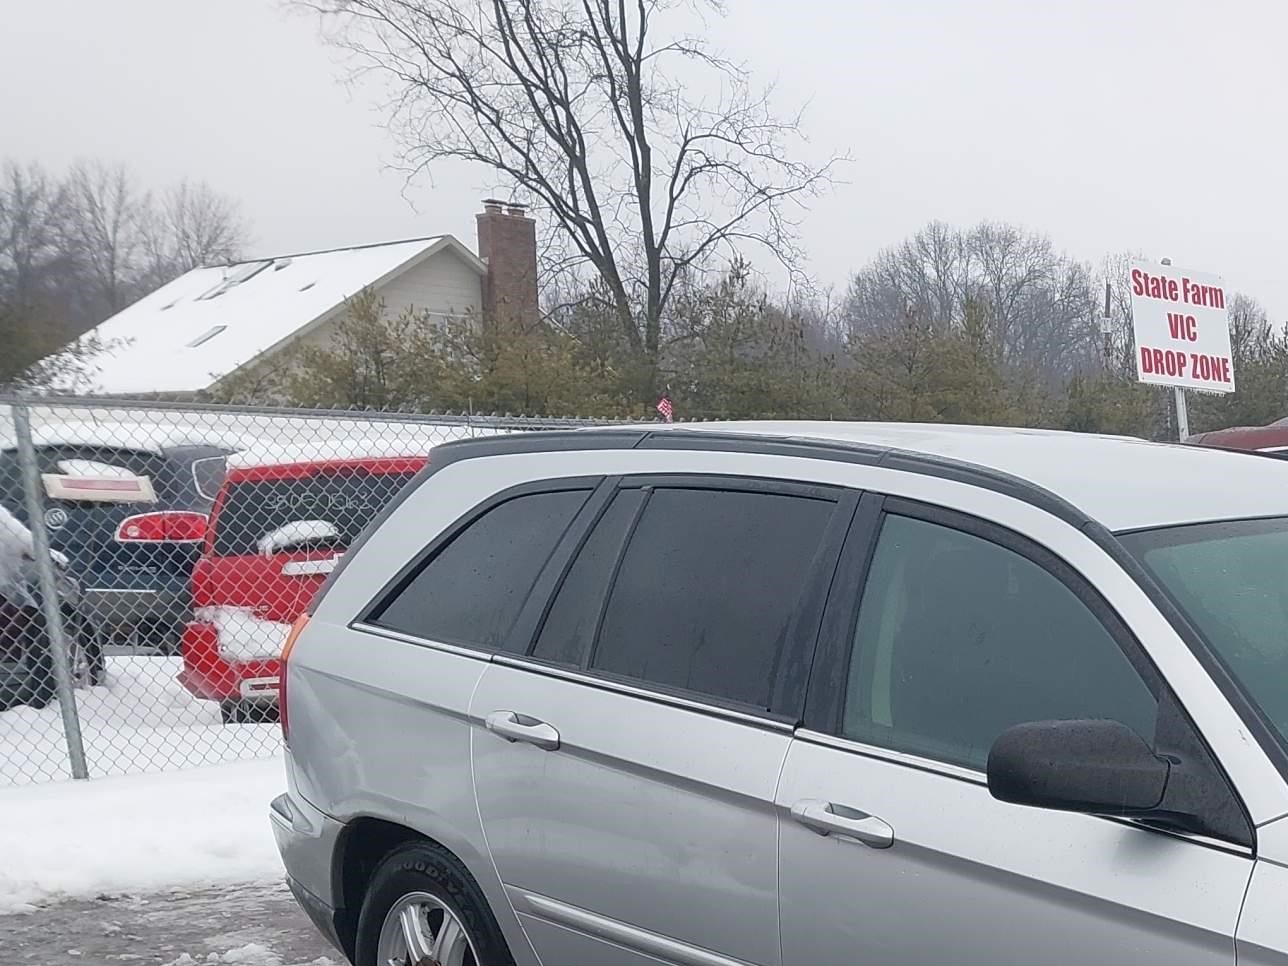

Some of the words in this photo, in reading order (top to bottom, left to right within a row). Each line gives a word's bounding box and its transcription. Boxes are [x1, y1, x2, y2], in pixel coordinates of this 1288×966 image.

[1131, 268, 1179, 302] State
[1181, 277, 1225, 310] Farm
[1167, 312, 1198, 342] VIC
[1140, 346, 1187, 378] DROP
[1190, 353, 1231, 383] ZONE
